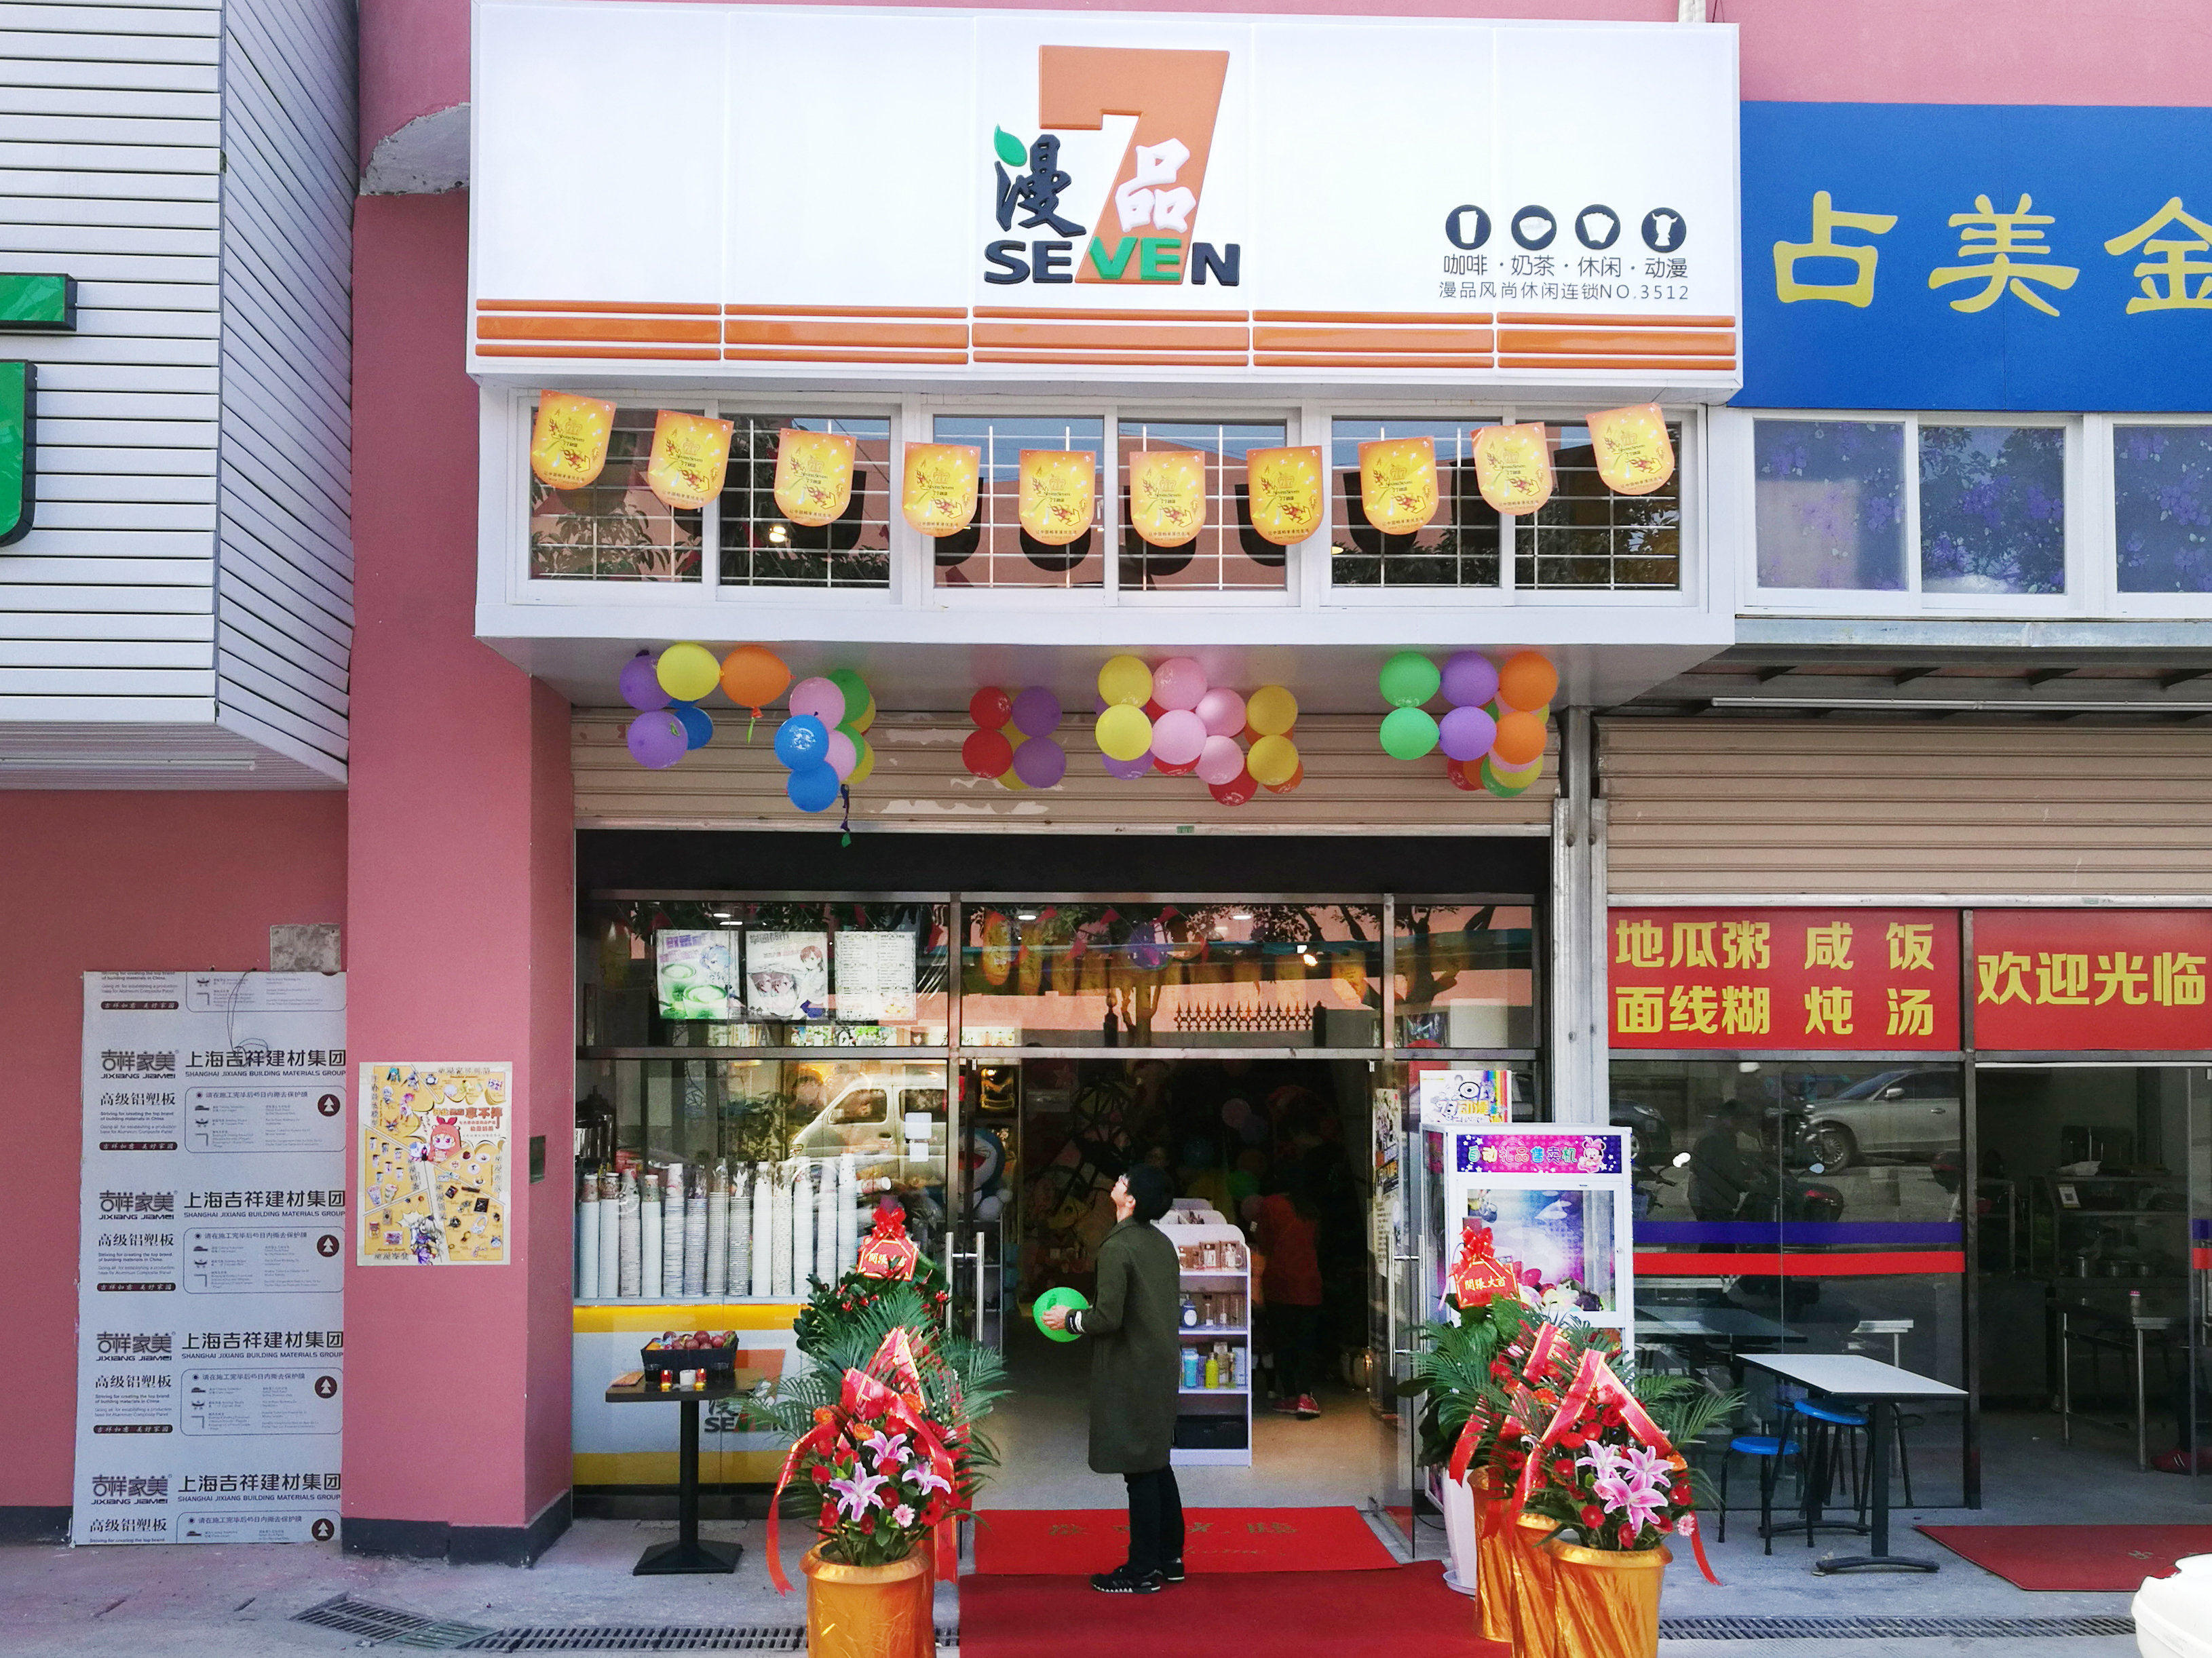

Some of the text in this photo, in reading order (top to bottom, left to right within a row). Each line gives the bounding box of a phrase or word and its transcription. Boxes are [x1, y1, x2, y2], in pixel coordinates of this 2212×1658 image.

[984, 237, 1240, 286] SEVEN
[1616, 920, 1770, 971] 地瓜粥
[1978, 950, 2206, 1007] 欢迎光临
[1616, 986, 1770, 1035] 面线糊
[185, 1049, 346, 1067] 上海吉祥建材集团
[100, 1092, 176, 1106] 高级铝塑板
[1468, 1144, 1578, 1163] 自动礼品售卖机
[184, 1191, 345, 1208] 上海吉祥建材集团
[98, 1233, 174, 1246] 高级铝塑板
[182, 1332, 343, 1349] 上海吉祥建材集团
[96, 1374, 172, 1388] 高级铝塑板
[178, 1473, 341, 1492] 上海吉祥建材集团
[90, 1518, 167, 1532] 高级铝塑板
